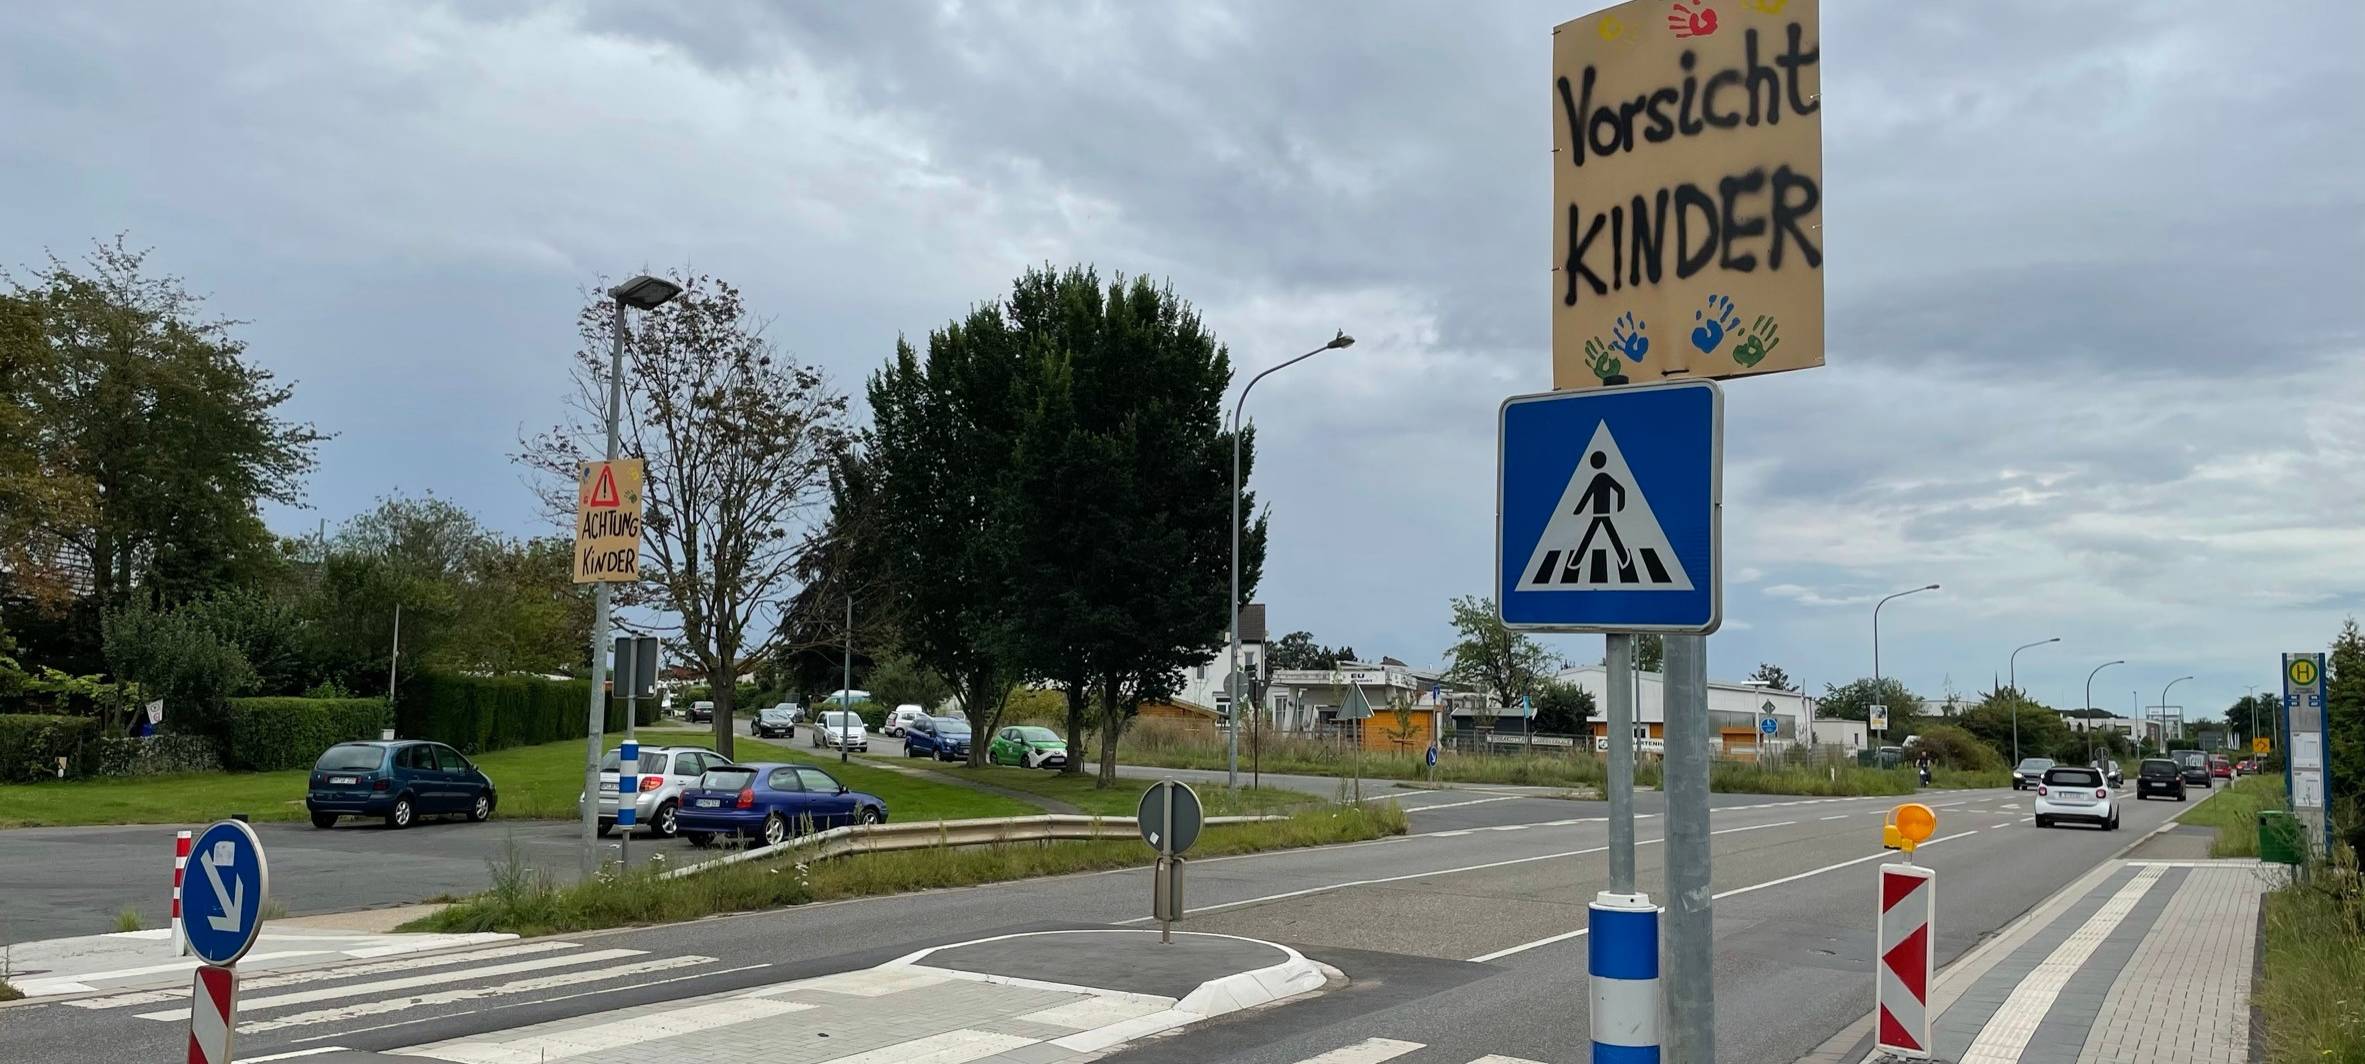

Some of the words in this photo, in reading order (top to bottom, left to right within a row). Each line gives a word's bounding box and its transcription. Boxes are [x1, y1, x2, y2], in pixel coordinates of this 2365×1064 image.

[1557, 22, 1820, 167] Vorsicht
[1565, 164, 1822, 307] KINDER
[582, 510, 639, 540] ACHTUNG
[2296, 664, 2310, 681] H
